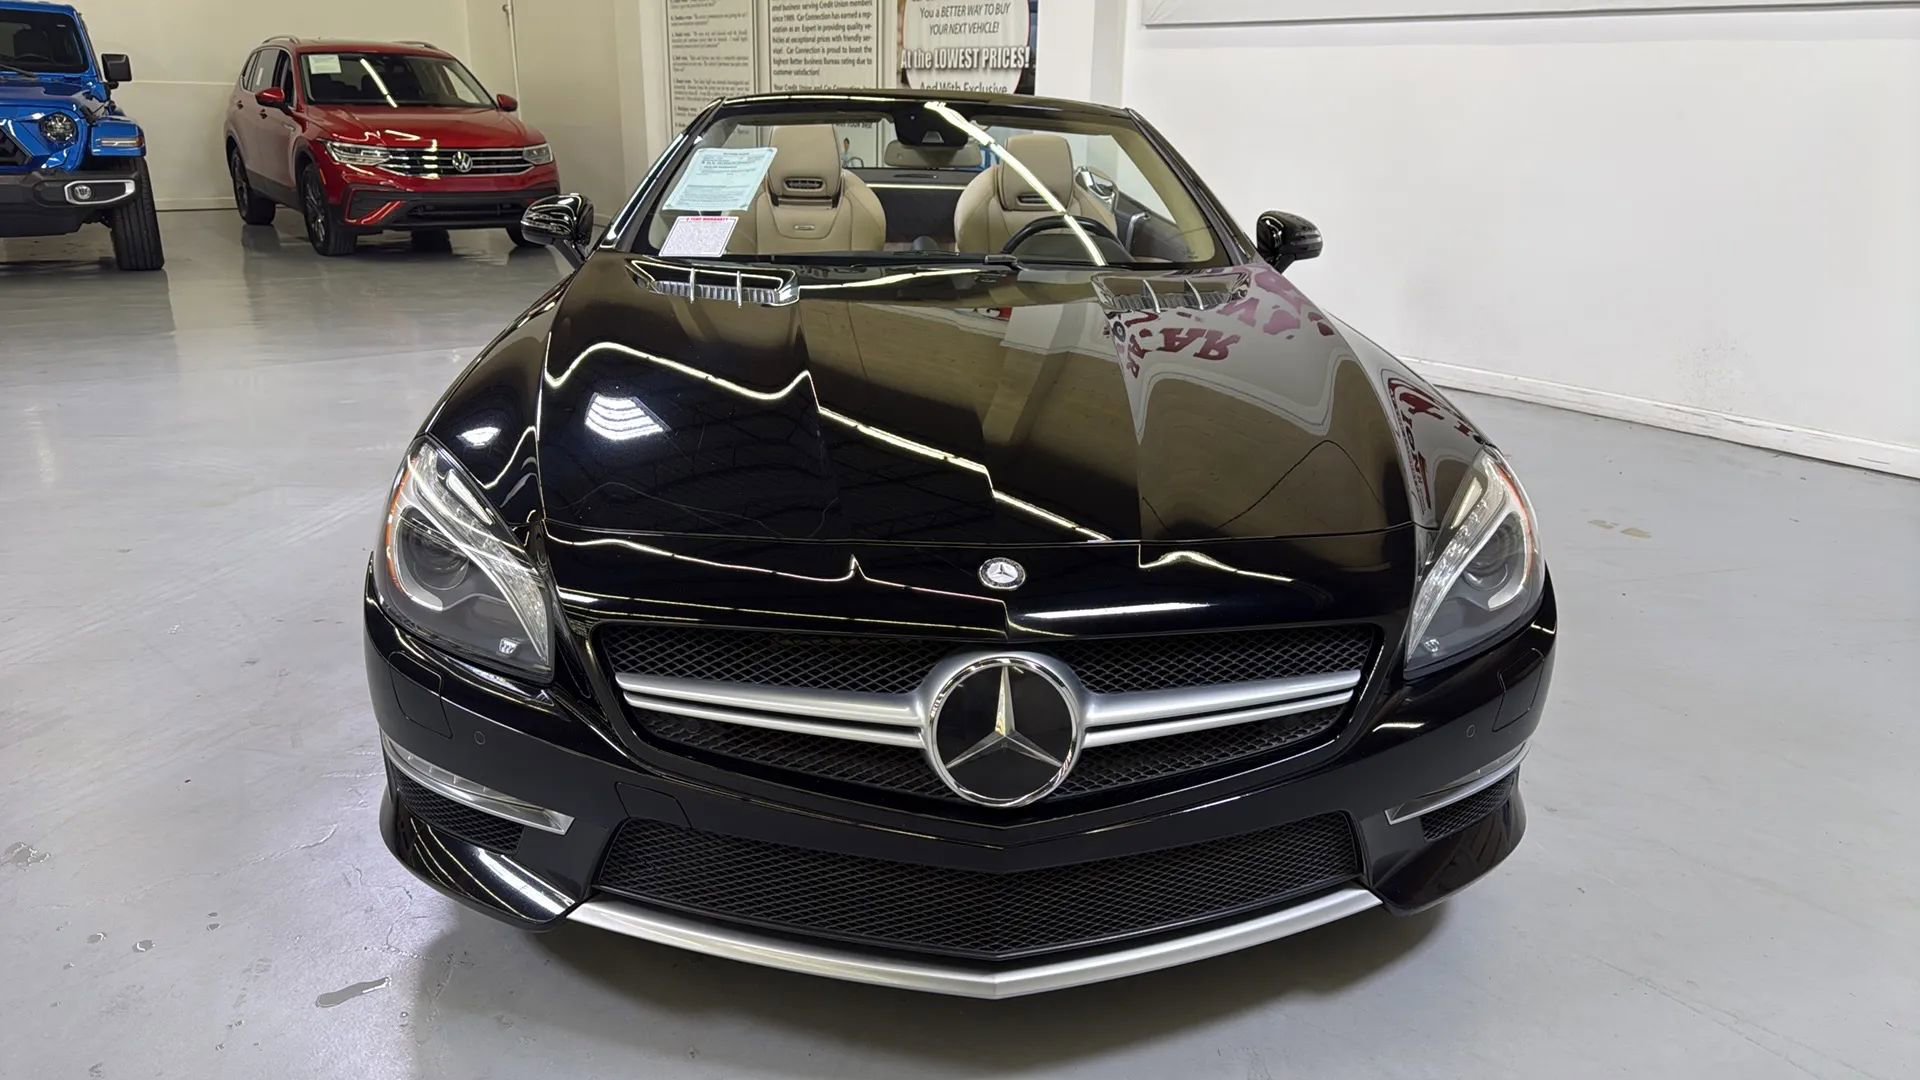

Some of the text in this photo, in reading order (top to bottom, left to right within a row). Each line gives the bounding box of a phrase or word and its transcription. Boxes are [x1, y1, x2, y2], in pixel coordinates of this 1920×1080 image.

[920, 2, 1011, 18] You a BETTER WAY TO BUY
[929, 21, 1000, 36] YOUR NEXT VEHICLE!
[901, 46, 1030, 70] At the LOWEST PRICES!
[963, 81, 1008, 94] Exclusive
